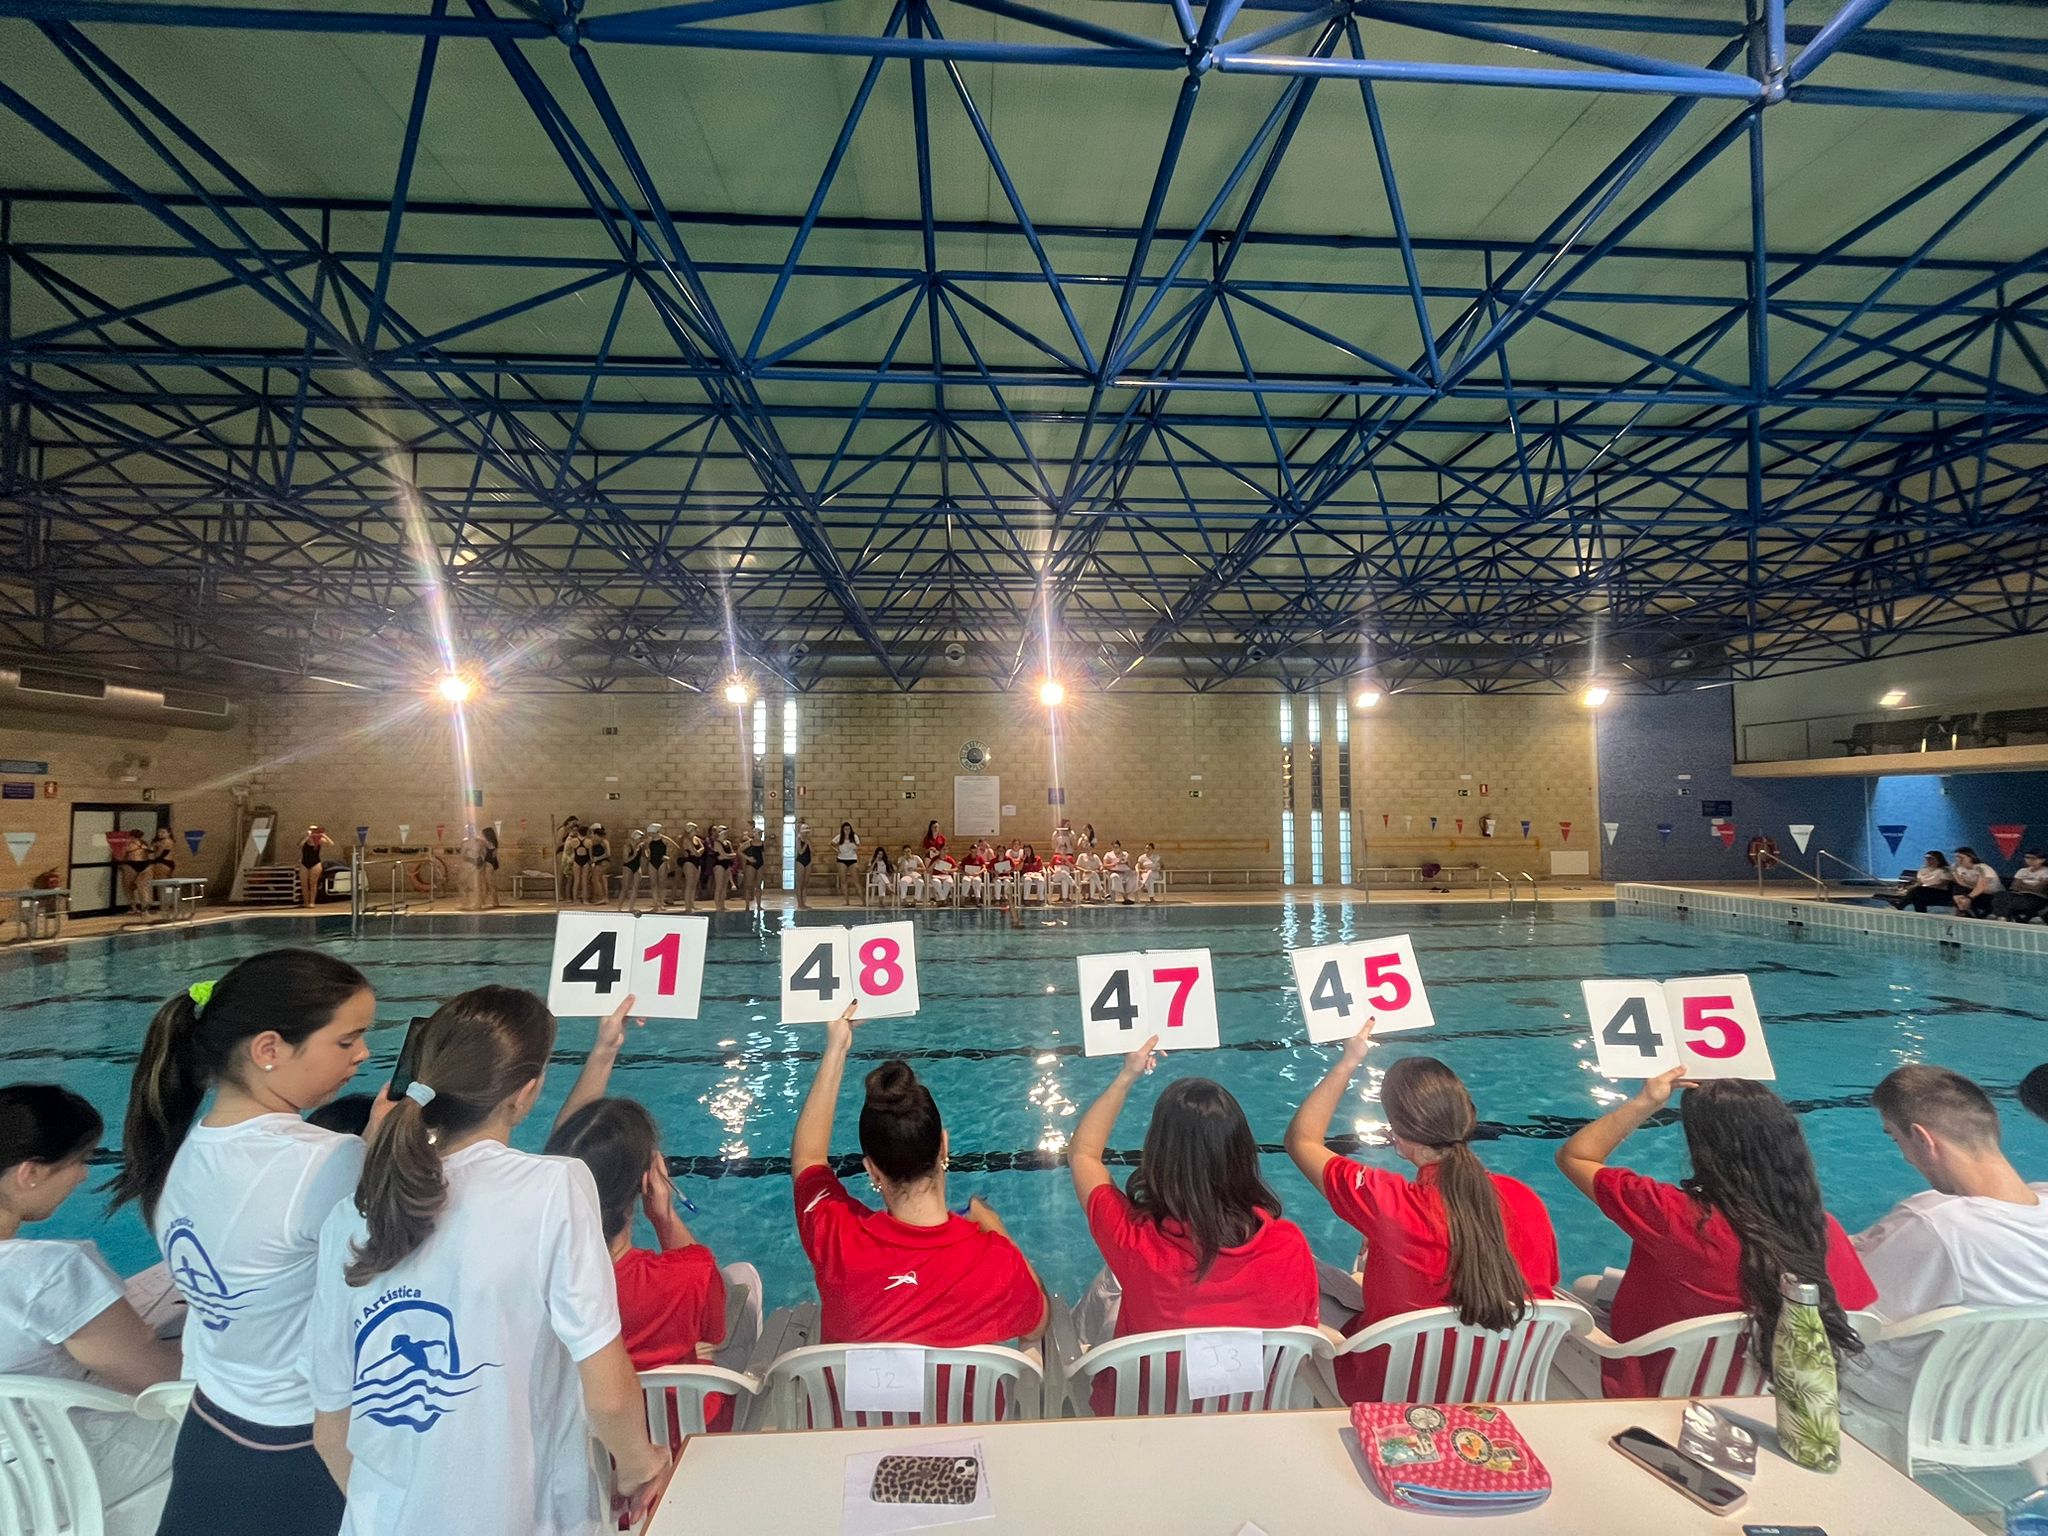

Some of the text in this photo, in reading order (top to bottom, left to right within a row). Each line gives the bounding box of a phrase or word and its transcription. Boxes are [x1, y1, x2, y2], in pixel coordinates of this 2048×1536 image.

[1791, 906, 1798, 918] 5
[1201, 1344, 1242, 1373] J3
[868, 1367, 904, 1389] J2
